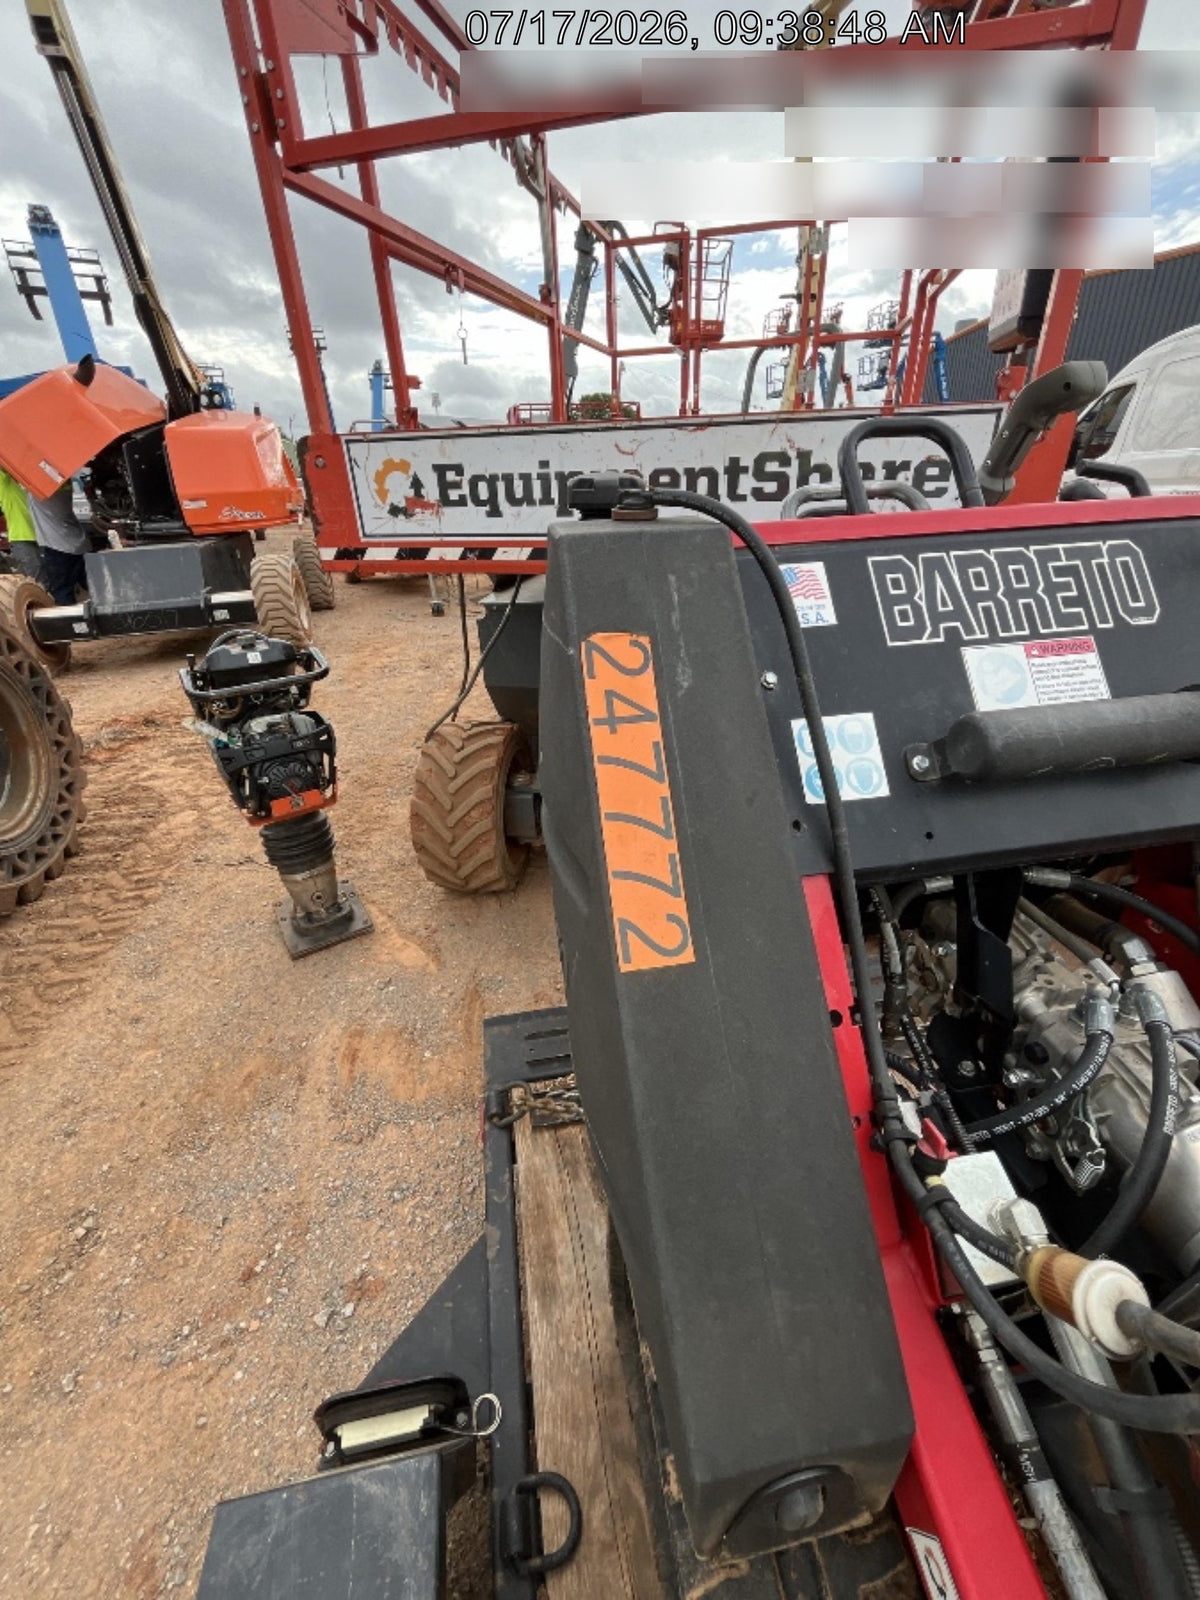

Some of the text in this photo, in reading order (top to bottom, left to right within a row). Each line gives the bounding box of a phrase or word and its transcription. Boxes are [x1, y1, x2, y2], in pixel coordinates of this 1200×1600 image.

[867, 539, 1161, 646] BARRETO
[1039, 641, 1092, 654] WARNING
[584, 638, 692, 966] 247772
